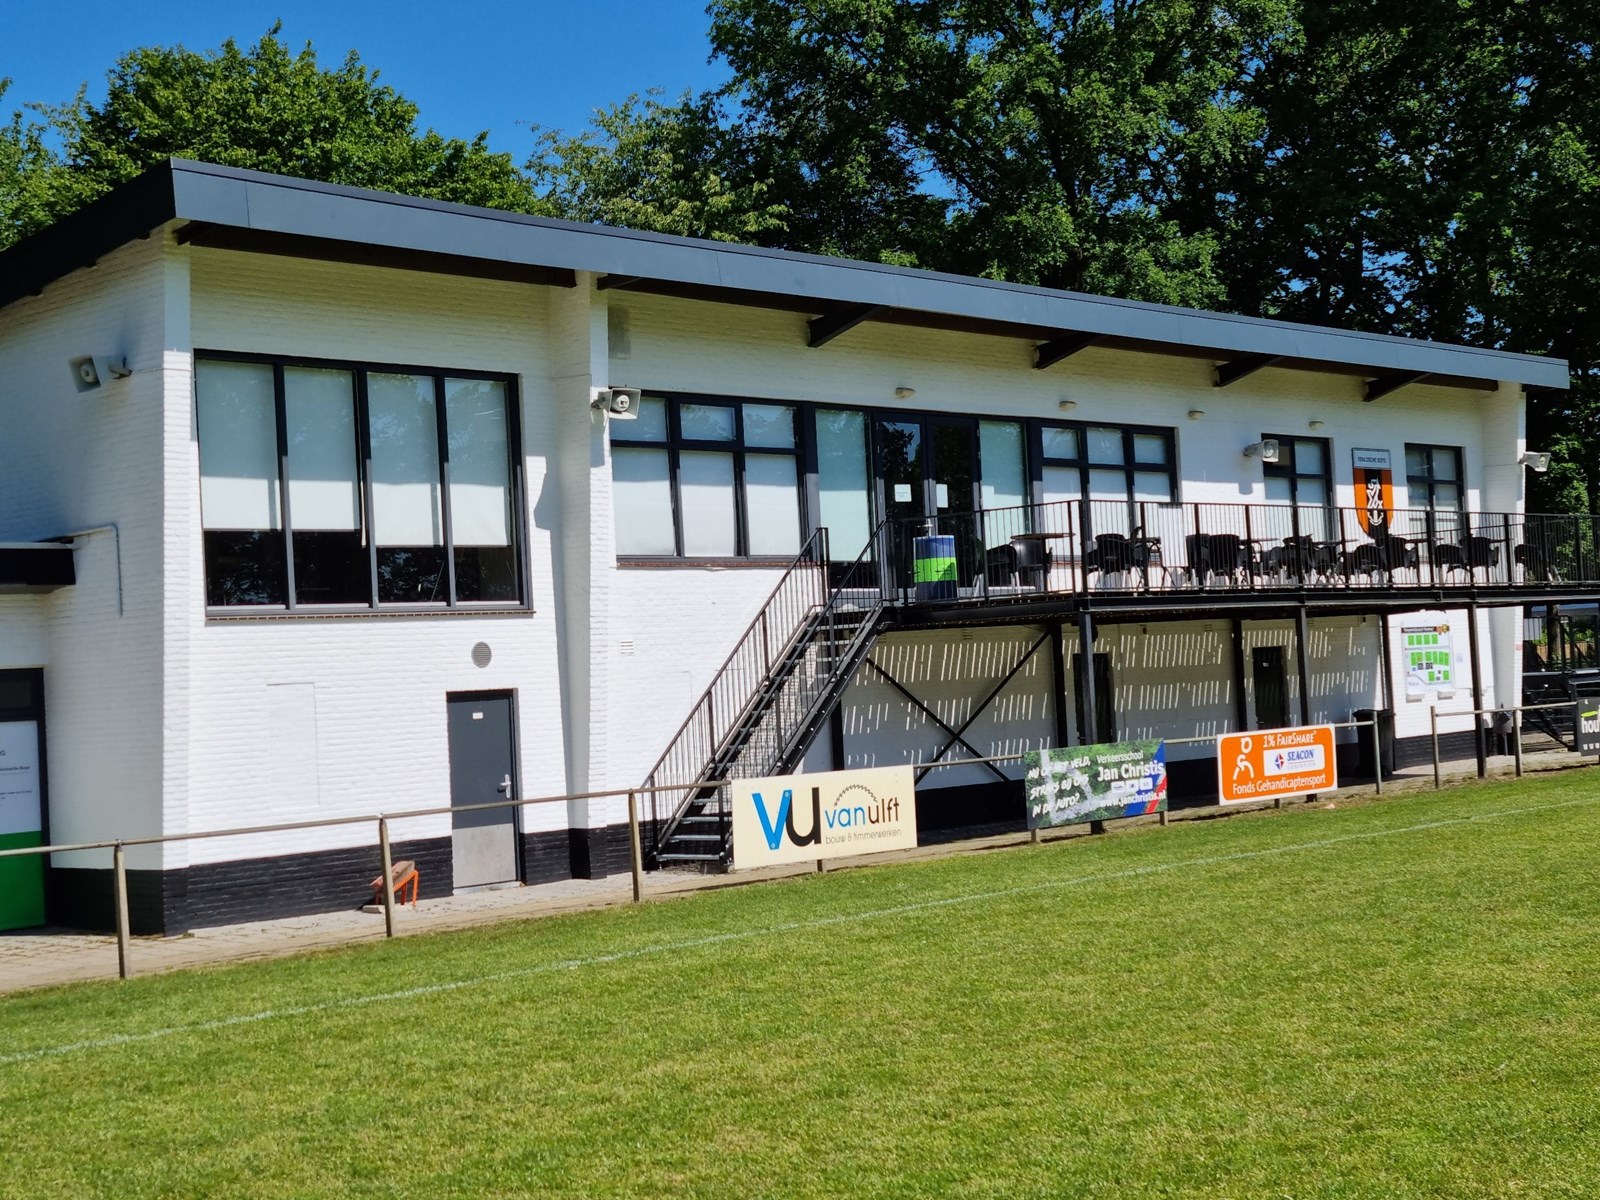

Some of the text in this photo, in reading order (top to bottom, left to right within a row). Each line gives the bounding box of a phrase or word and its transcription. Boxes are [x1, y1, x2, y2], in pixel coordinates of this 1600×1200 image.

[1263, 735, 1275, 747] 1%
[1097, 750, 1144, 764] Verkeersschool
[1287, 749, 1315, 761] SEACON
[1097, 760, 1164, 781] Jan Christis
[1233, 774, 1326, 795] Fonds Gehandicaptensport
[826, 833, 847, 845] bouw
[853, 828, 902, 841] timmerwerken
